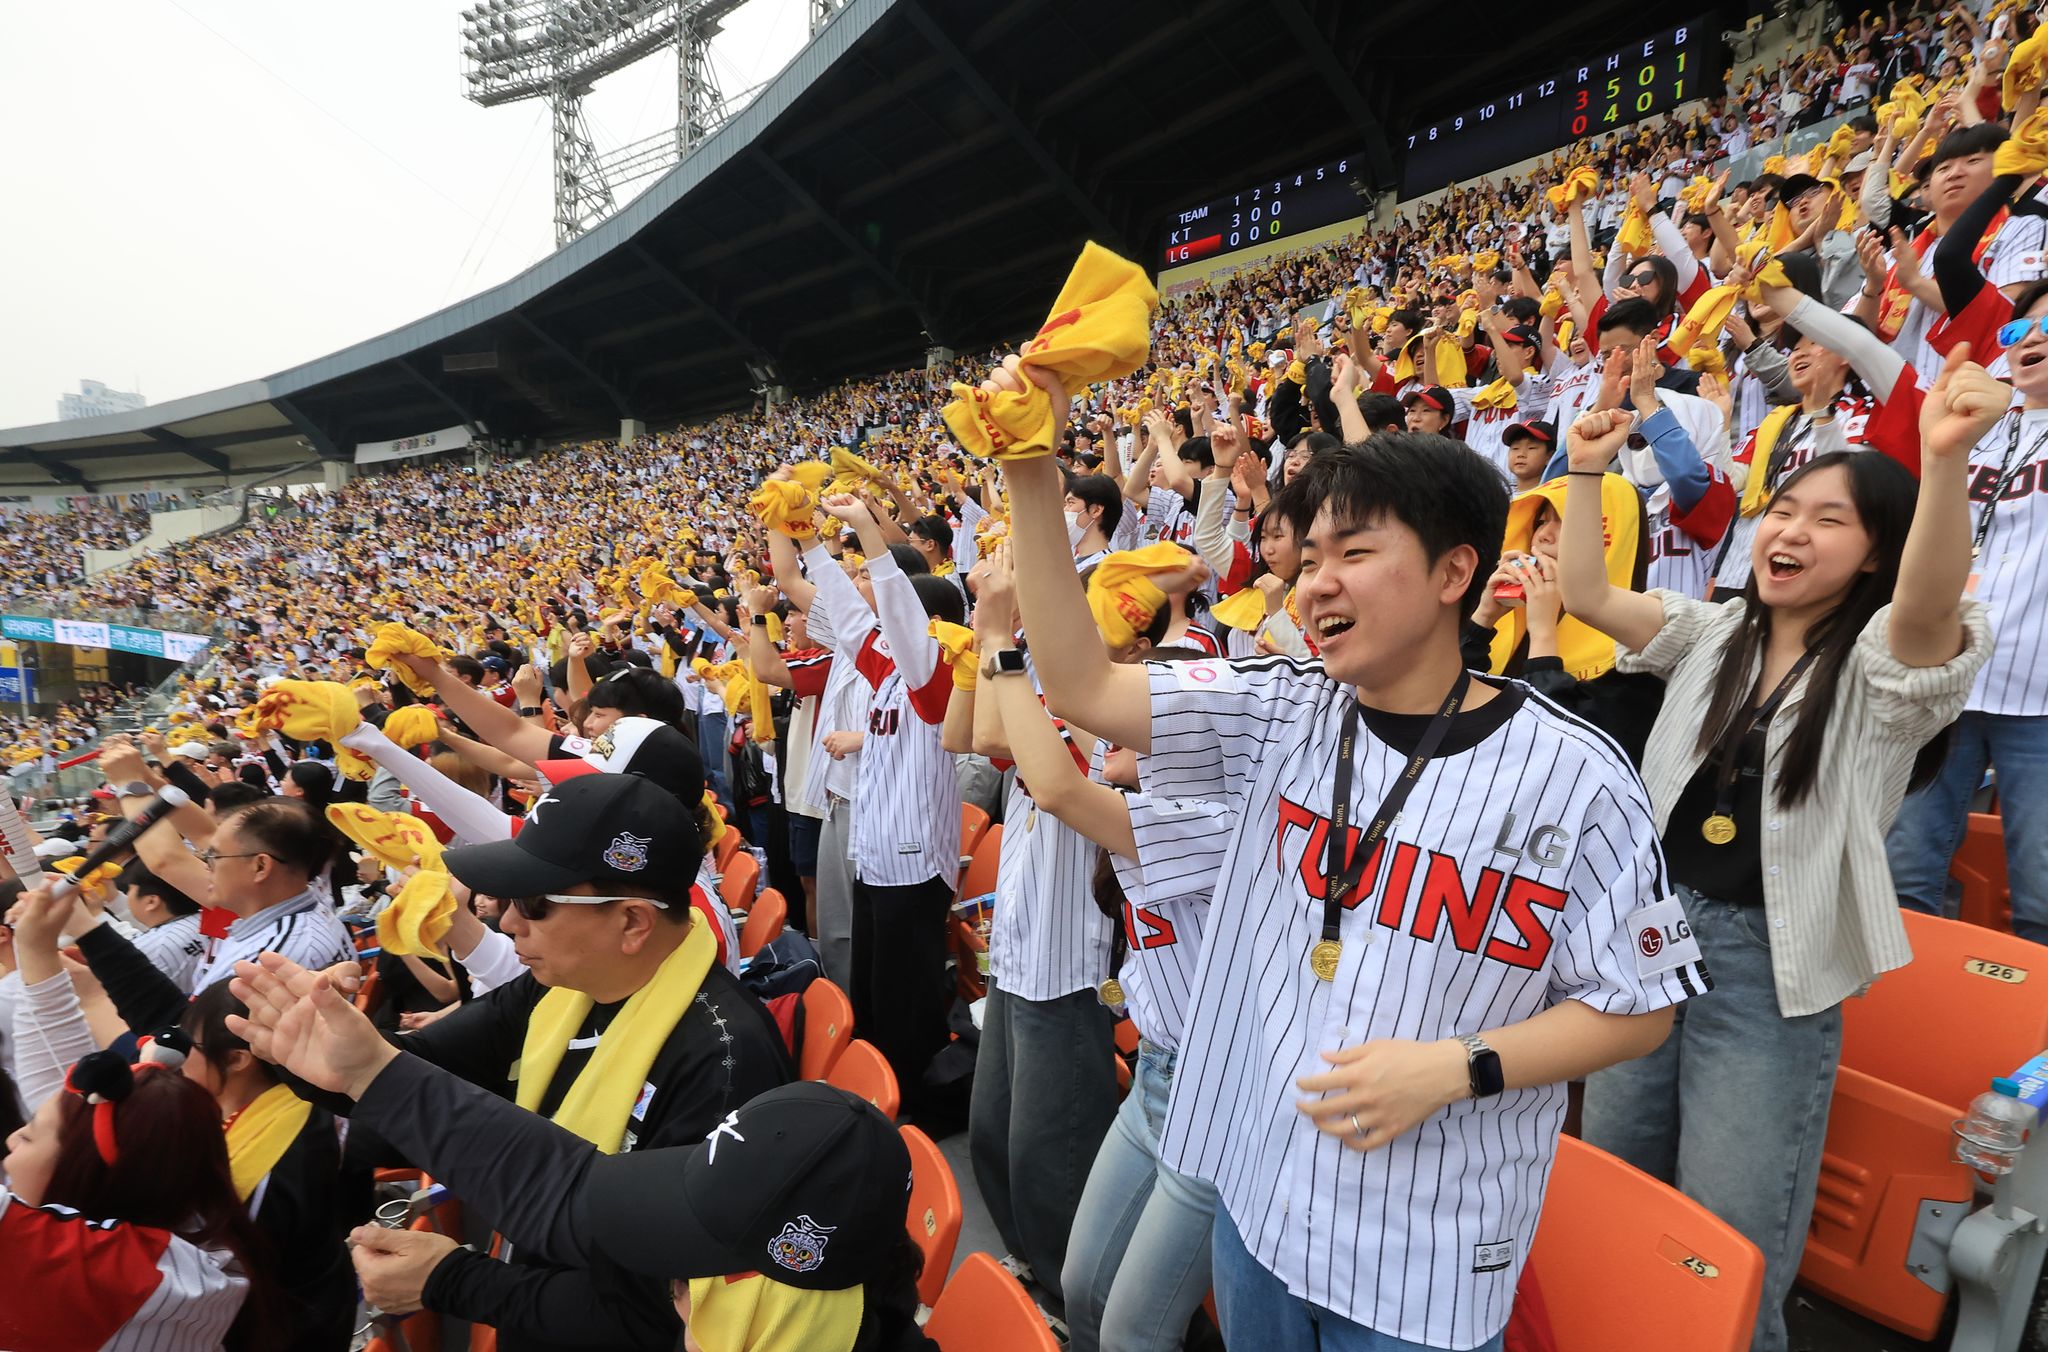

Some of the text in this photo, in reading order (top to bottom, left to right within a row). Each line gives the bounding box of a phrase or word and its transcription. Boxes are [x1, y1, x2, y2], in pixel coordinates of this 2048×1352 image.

[1408, 27, 1687, 150] 7 8 9 10 11 12 R H E B
[1575, 52, 1686, 111] 3 5 0 1
[1572, 79, 1683, 135] 0 4 0 1
[1178, 160, 1347, 224] TEAM 1 2 3 4 5 6
[1231, 213, 1241, 228] 3
[1250, 207, 1261, 222] 0
[1271, 200, 1282, 216] 0
[1230, 231, 1240, 246] 0
[1249, 225, 1260, 241] 0
[1269, 219, 1281, 235] 0
[1443, 696, 1459, 718] TWINS
[1341, 736, 1351, 760] TWINS
[1406, 756, 1425, 780] TWINS
[1335, 803, 1345, 828] TWINS
[1367, 819, 1386, 843] TWINS
[1492, 810, 1571, 869] LG
[1277, 794, 1569, 972] TWINS
[1663, 919, 1691, 946] LG
[1976, 962, 2015, 979] 126
[1682, 1256, 1707, 1275] 25
